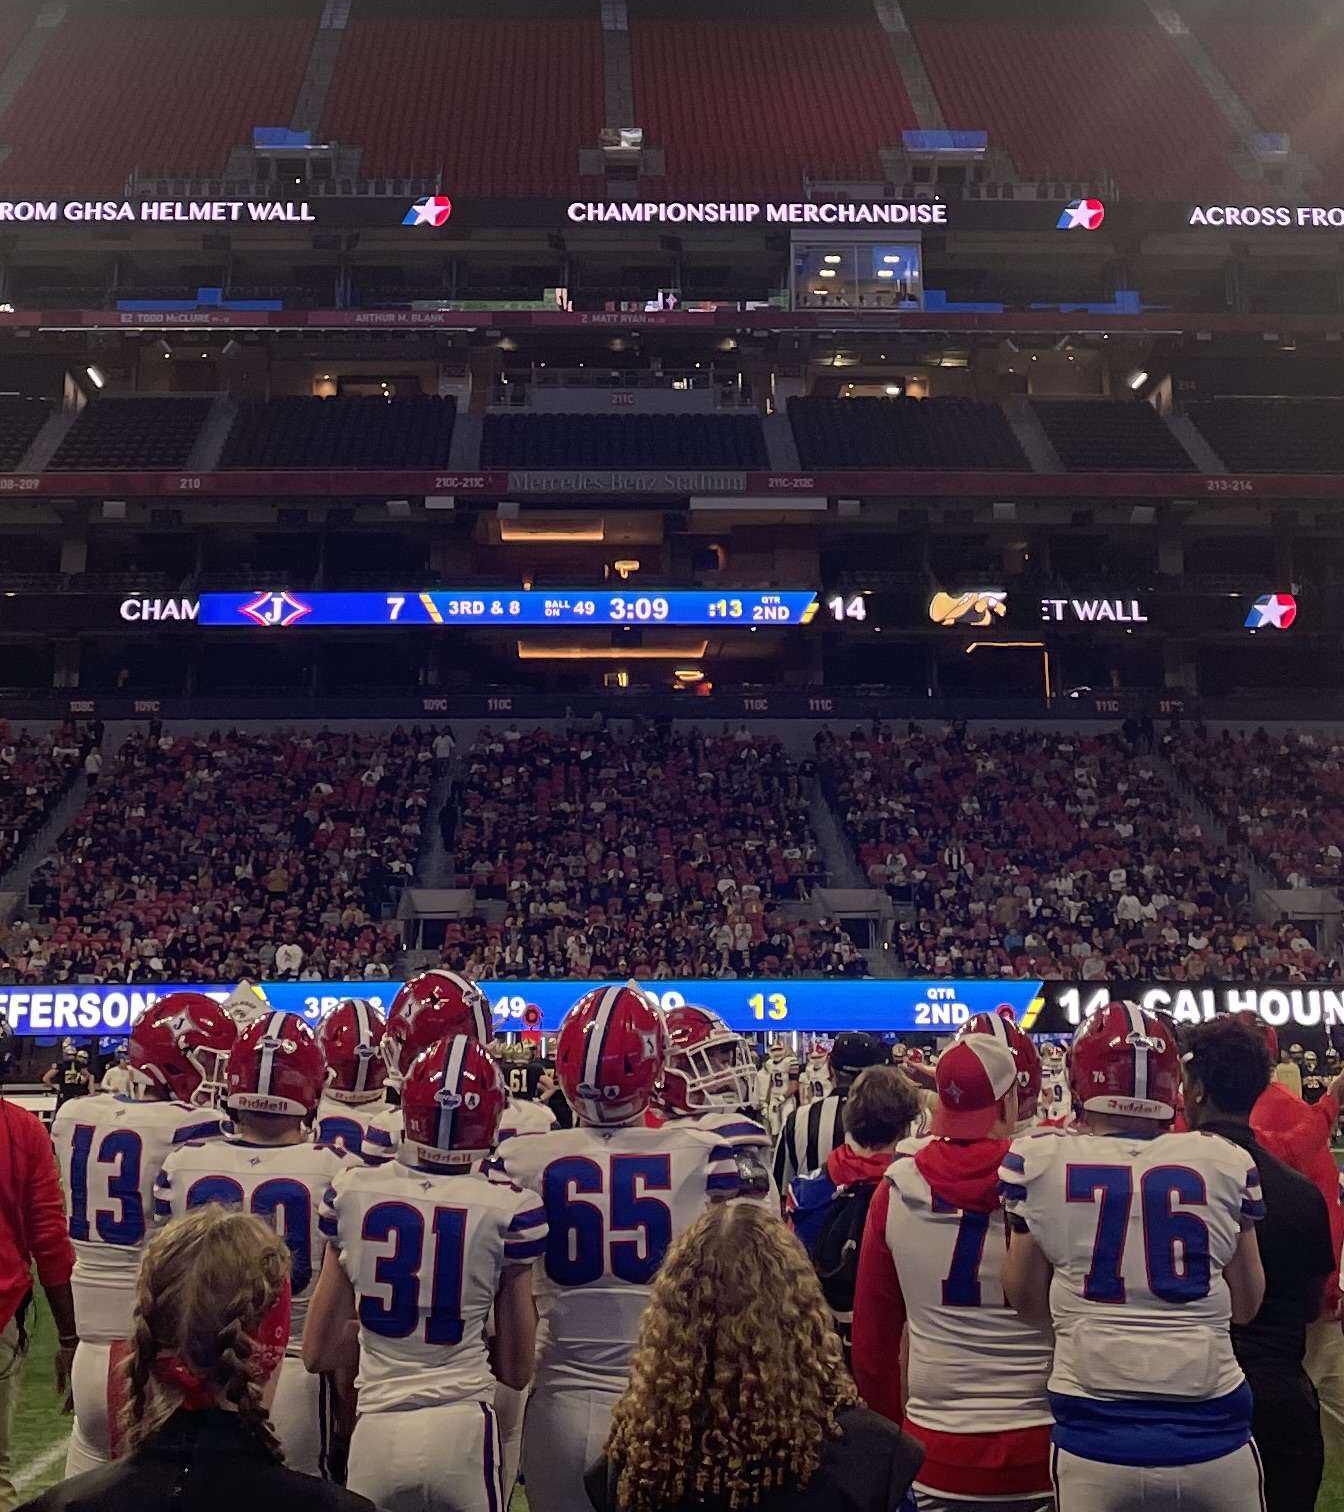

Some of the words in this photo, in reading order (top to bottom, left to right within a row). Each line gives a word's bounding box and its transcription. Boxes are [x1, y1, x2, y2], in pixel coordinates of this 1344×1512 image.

[64, 202, 136, 222] GHSA
[142, 202, 244, 222] HELMET
[249, 202, 317, 222] WALL
[568, 203, 760, 223] CHAMPIONSHIP
[767, 204, 948, 224] MERCHANDISE
[1190, 207, 1291, 227] ACROSS
[356, 313, 395, 323] ARTHUR
[411, 313, 444, 323] BLANK
[592, 314, 618, 323] MATT
[620, 314, 646, 323] RYAN
[179, 478, 201, 489] 210
[511, 474, 656, 491] Mercedes-Benz
[664, 474, 743, 491] Stadium
[264, 597, 284, 621] J
[387, 597, 405, 620] 7
[448, 601, 485, 615] 3RD
[490, 601, 504, 615] &
[509, 601, 520, 615] 8
[544, 600, 571, 609] BALL
[573, 601, 595, 616] 49
[609, 597, 669, 620] 3:09
[760, 595, 781, 605] QTR
[828, 596, 867, 621] 14
[120, 598, 200, 621] CHAM
[544, 609, 561, 617] ON
[752, 605, 790, 621] 2ND
[1072, 600, 1148, 621] WALL
[134, 701, 160, 712] 109C
[423, 699, 447, 710] 109C
[487, 699, 512, 710] 110C
[744, 699, 768, 711] 110C
[809, 699, 833, 711] 111C
[1095, 700, 1119, 711] 111C
[927, 988, 955, 1000] QTR
[494, 997, 525, 1018] 49
[749, 994, 787, 1020] 13
[914, 1002, 970, 1025] 2ND
[173, 1017, 184, 1030] J
[510, 1069, 527, 1092] 61
[69, 1124, 145, 1247] 13
[542, 1153, 671, 1286] 65
[186, 1176, 312, 1296] 0
[1066, 1163, 1210, 1304] 76
[358, 1201, 468, 1345] 31
